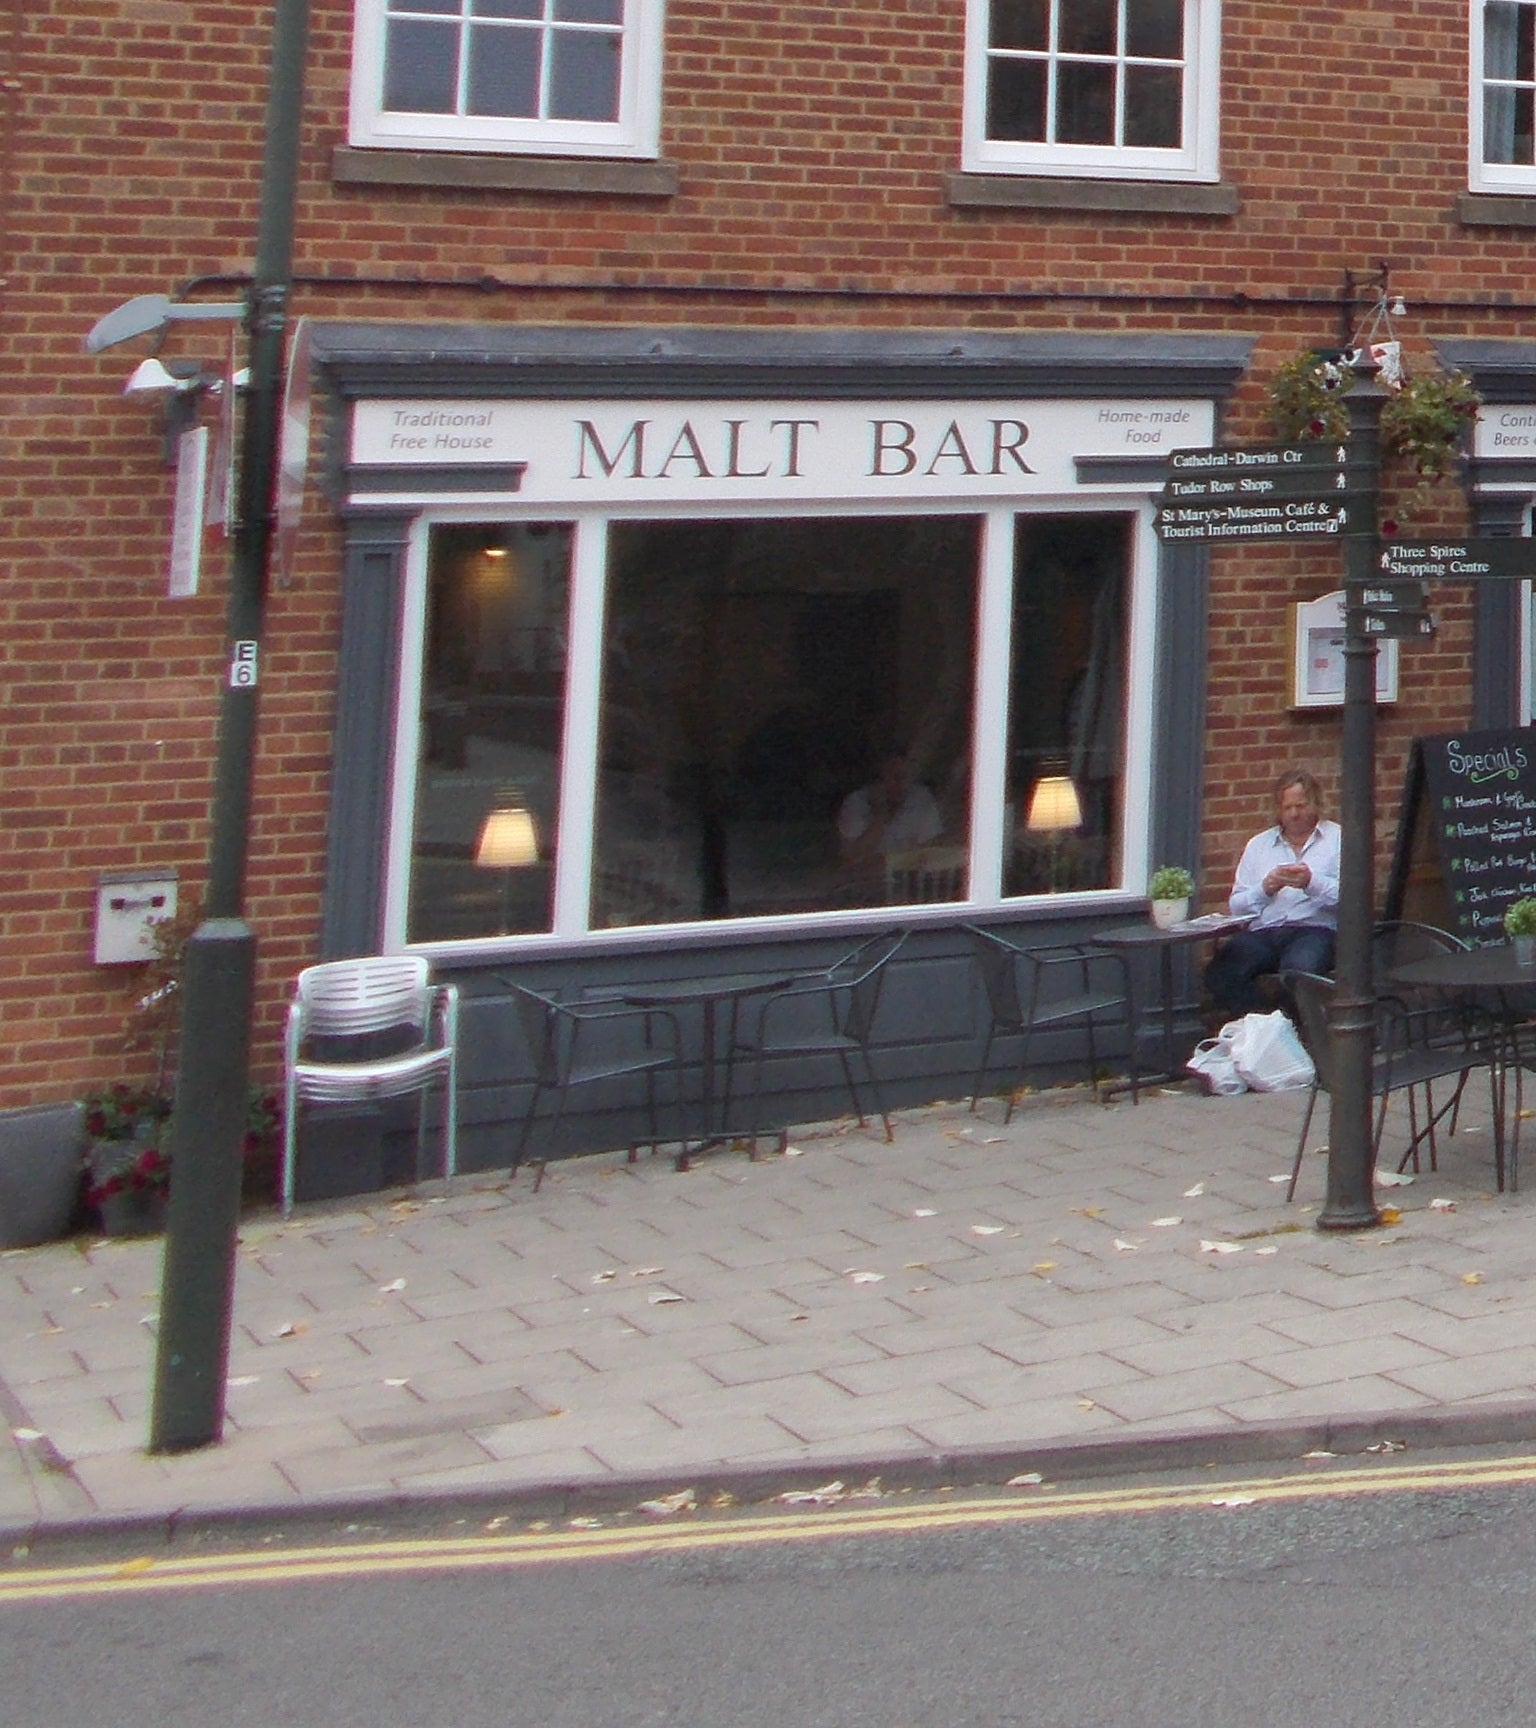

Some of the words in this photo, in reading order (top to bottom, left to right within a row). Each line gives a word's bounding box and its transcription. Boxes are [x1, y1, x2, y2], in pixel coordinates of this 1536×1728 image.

[393, 410, 493, 426] Traditional
[1098, 408, 1190, 424] Home-made
[390, 433, 426, 449] Free
[434, 433, 493, 449] House
[1125, 429, 1161, 444] Food
[1494, 432, 1529, 446] Beers
[573, 419, 820, 478] MALT
[865, 419, 1038, 477] BAR
[1173, 451, 1279, 468] Cathedral-Darwin
[1283, 449, 1303, 464] Ctr
[1172, 481, 1206, 496] Tudor
[1210, 480, 1235, 493] Row
[1240, 478, 1273, 493] Shops
[1162, 508, 1175, 523] St
[1285, 501, 1315, 516] Café
[1318, 502, 1330, 515] &
[1162, 522, 1204, 538] Tourist
[1208, 520, 1283, 537] Information
[1286, 518, 1326, 533] Centre
[1390, 546, 1426, 558] Three
[1430, 545, 1467, 559] Spires
[1390, 562, 1445, 577] Shopping
[1450, 560, 1490, 573] Centre
[238, 643, 256, 662] E
[237, 665, 252, 683] 6
